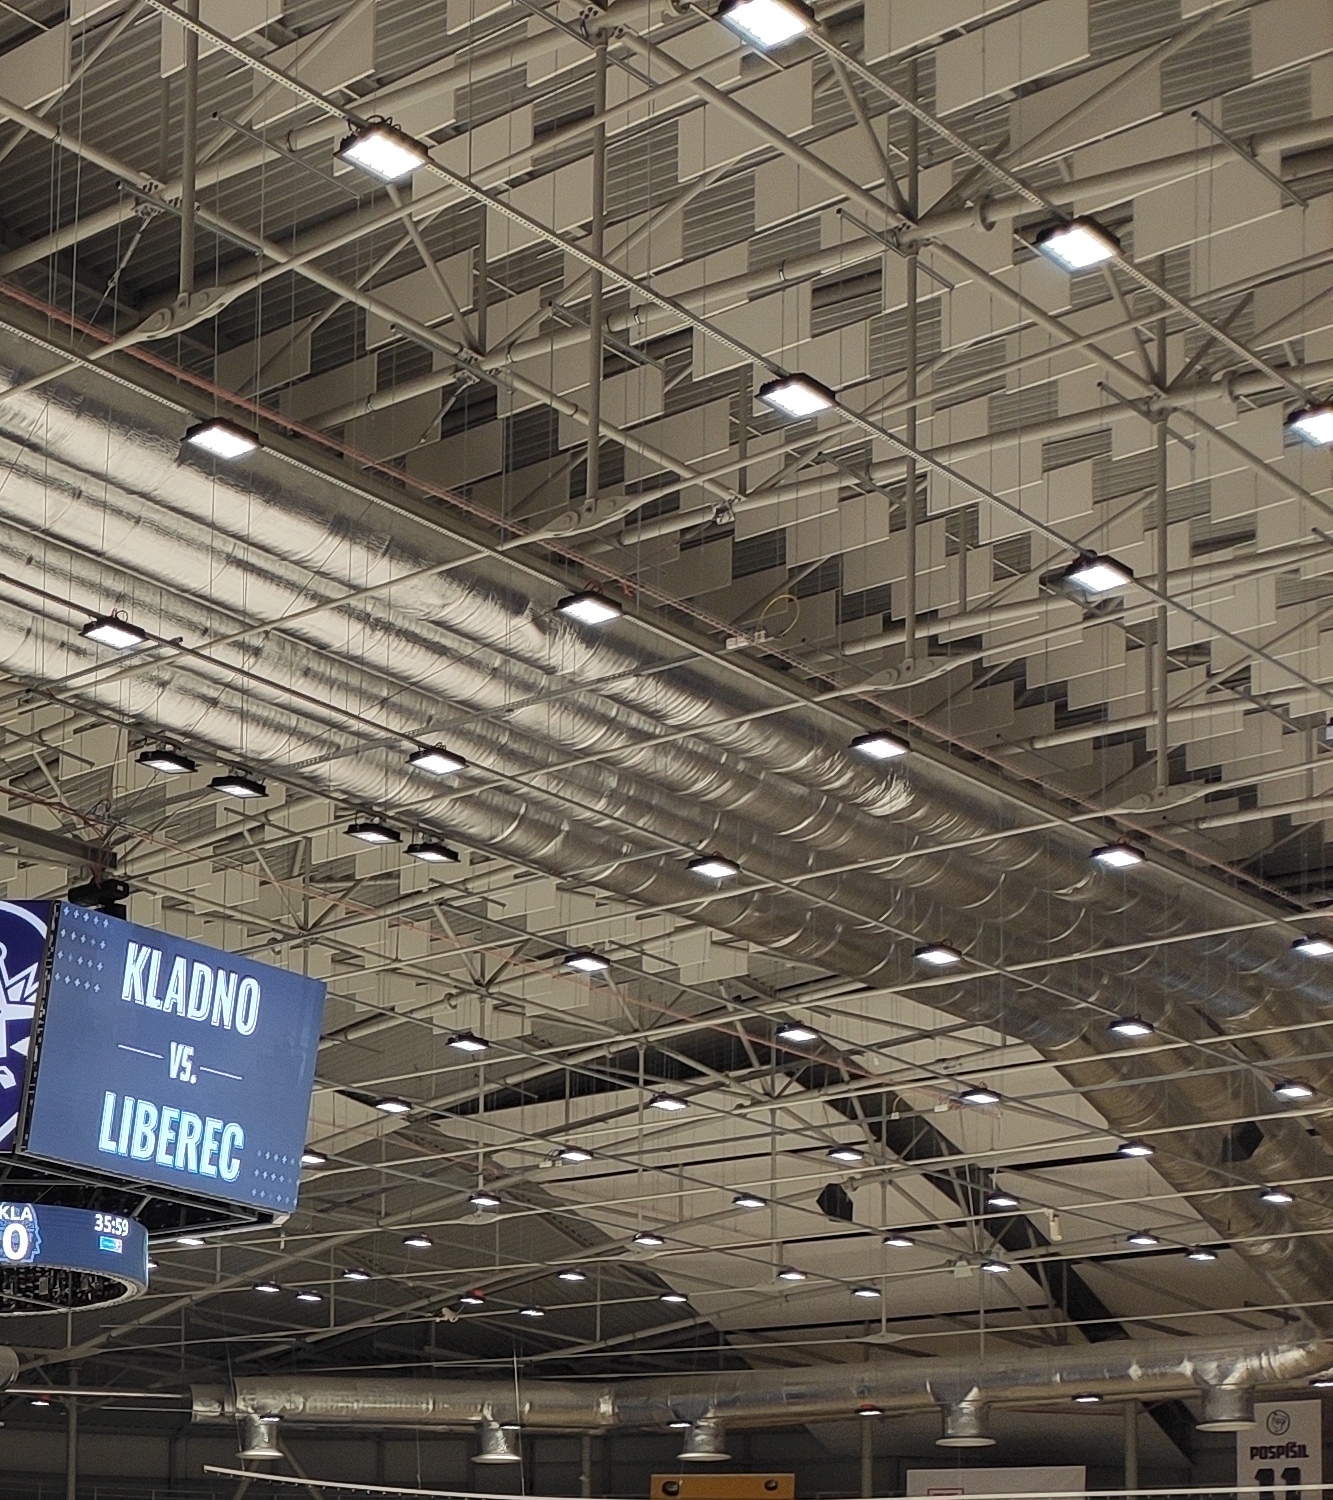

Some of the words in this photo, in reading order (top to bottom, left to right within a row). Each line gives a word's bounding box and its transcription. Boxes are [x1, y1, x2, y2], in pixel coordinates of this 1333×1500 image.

[121, 941, 262, 1037] KLADNO
[169, 1041, 198, 1084] VS.
[98, 1092, 245, 1182] LIBEREC
[2, 1223, 28, 1260] 0
[94, 1213, 129, 1237] 35:59
